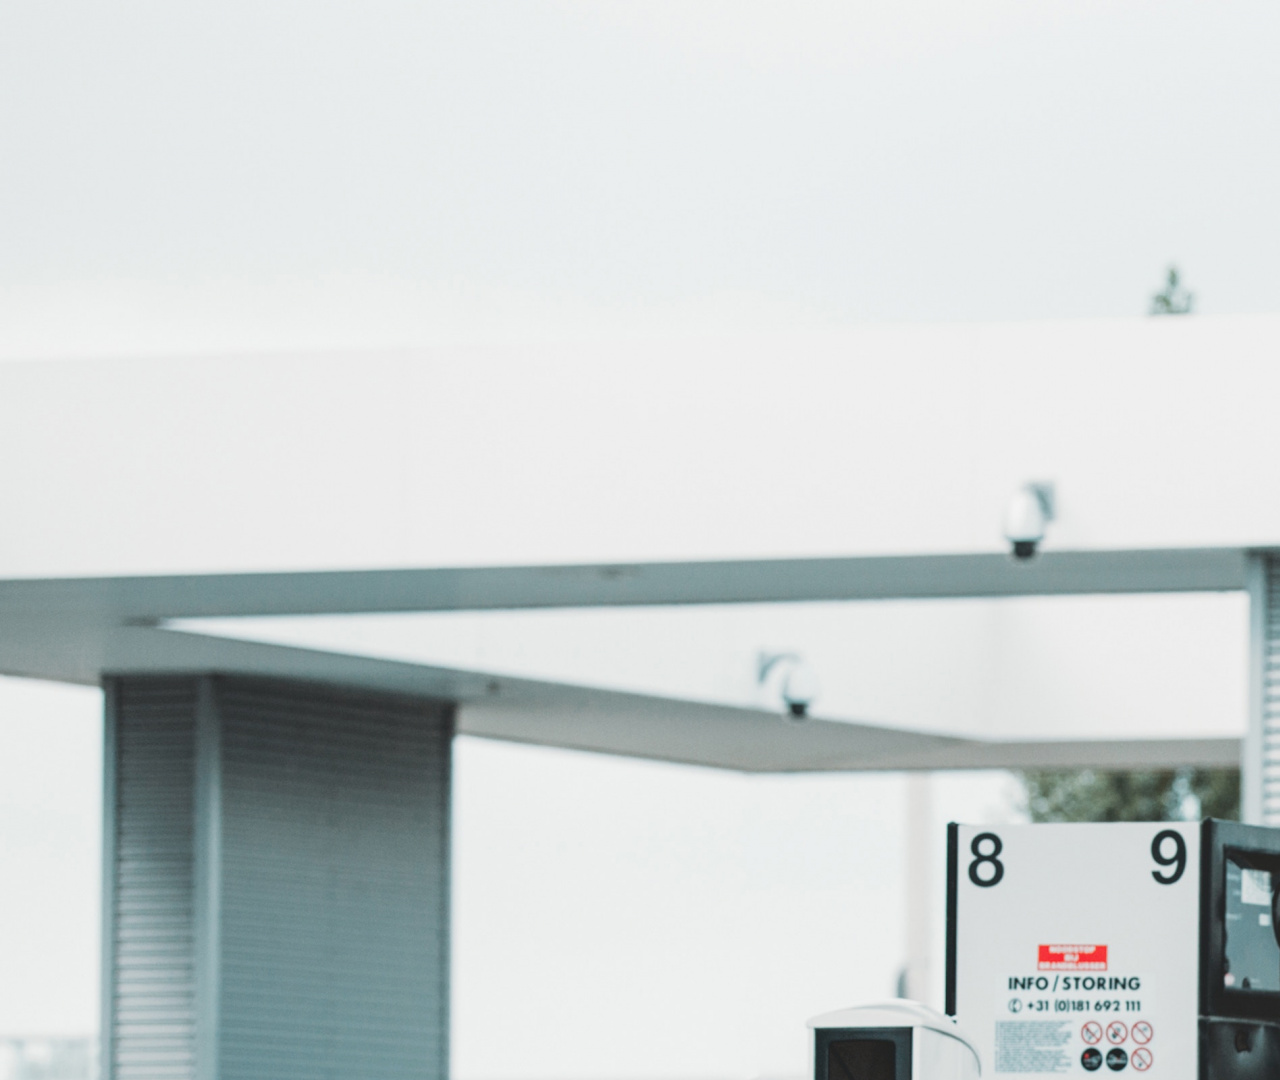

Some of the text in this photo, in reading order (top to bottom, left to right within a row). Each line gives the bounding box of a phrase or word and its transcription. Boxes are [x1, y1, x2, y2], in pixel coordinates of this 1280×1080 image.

[968, 832, 1005, 887] 8
[1150, 829, 1188, 885] 9
[1008, 976, 1049, 990] INFO
[1062, 976, 1141, 991] STORING
[1027, 998, 1141, 1013] +31 (0)181 692 111
